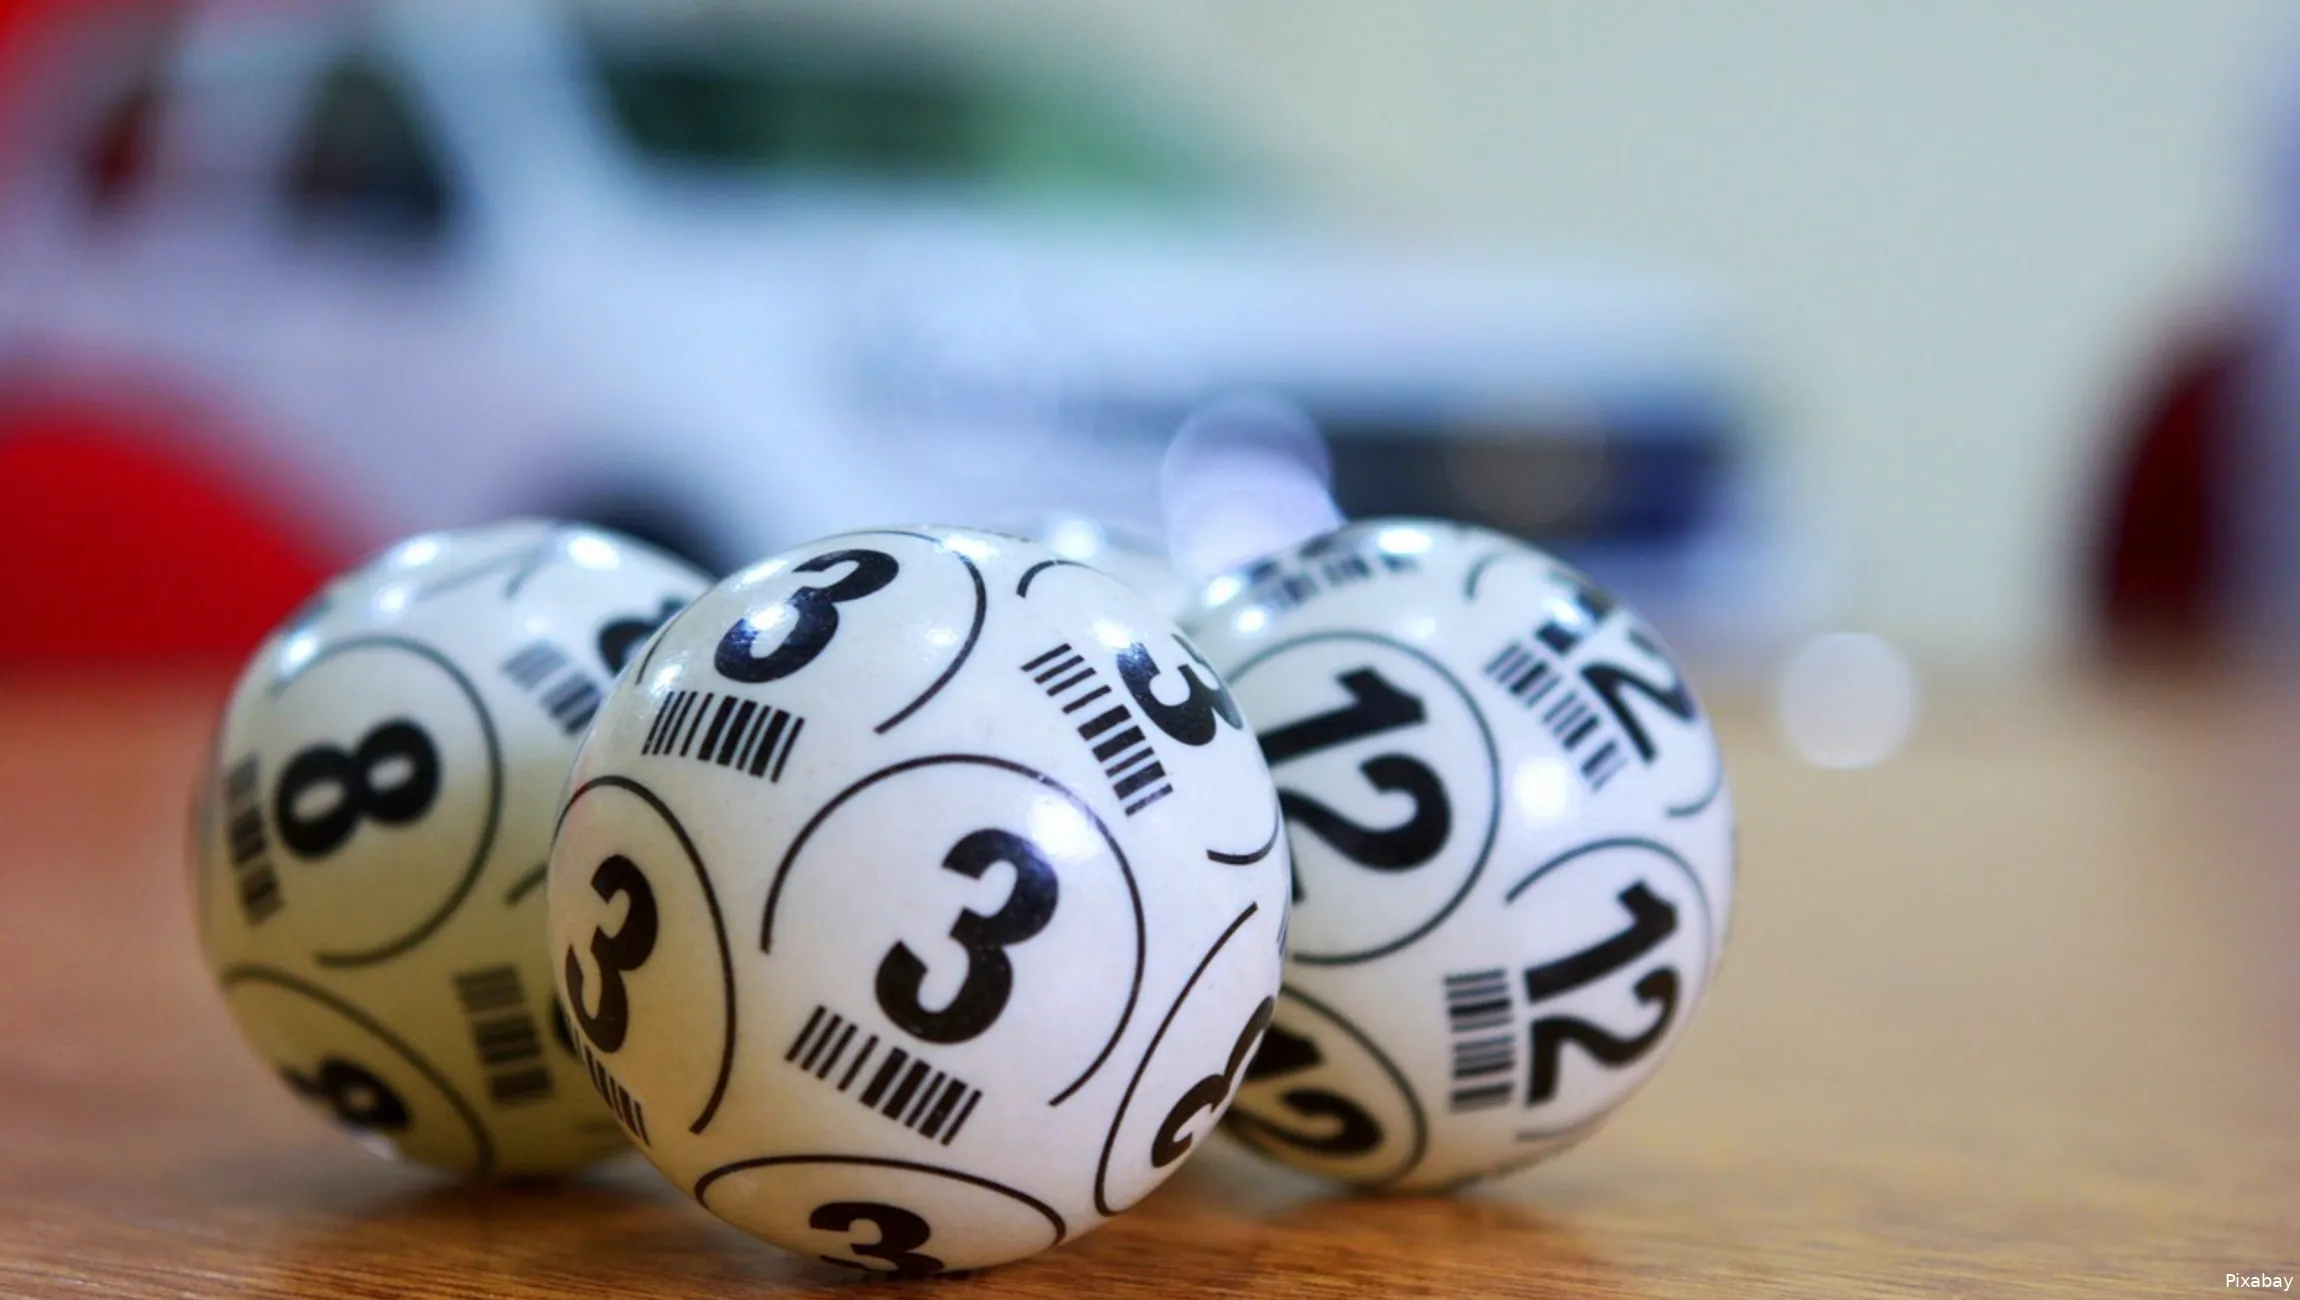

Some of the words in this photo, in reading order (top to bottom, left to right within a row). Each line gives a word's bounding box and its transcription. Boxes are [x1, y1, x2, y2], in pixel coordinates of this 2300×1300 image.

[714, 549, 900, 684] 3
[1116, 632, 1244, 747] 3
[273, 718, 440, 861] 8
[1256, 666, 1453, 904] 12
[565, 854, 659, 1054] 3
[874, 828, 1060, 1044] 3
[1524, 880, 1682, 1108] 12
[1151, 995, 1275, 1168] 3
[808, 1201, 946, 1281] 3
